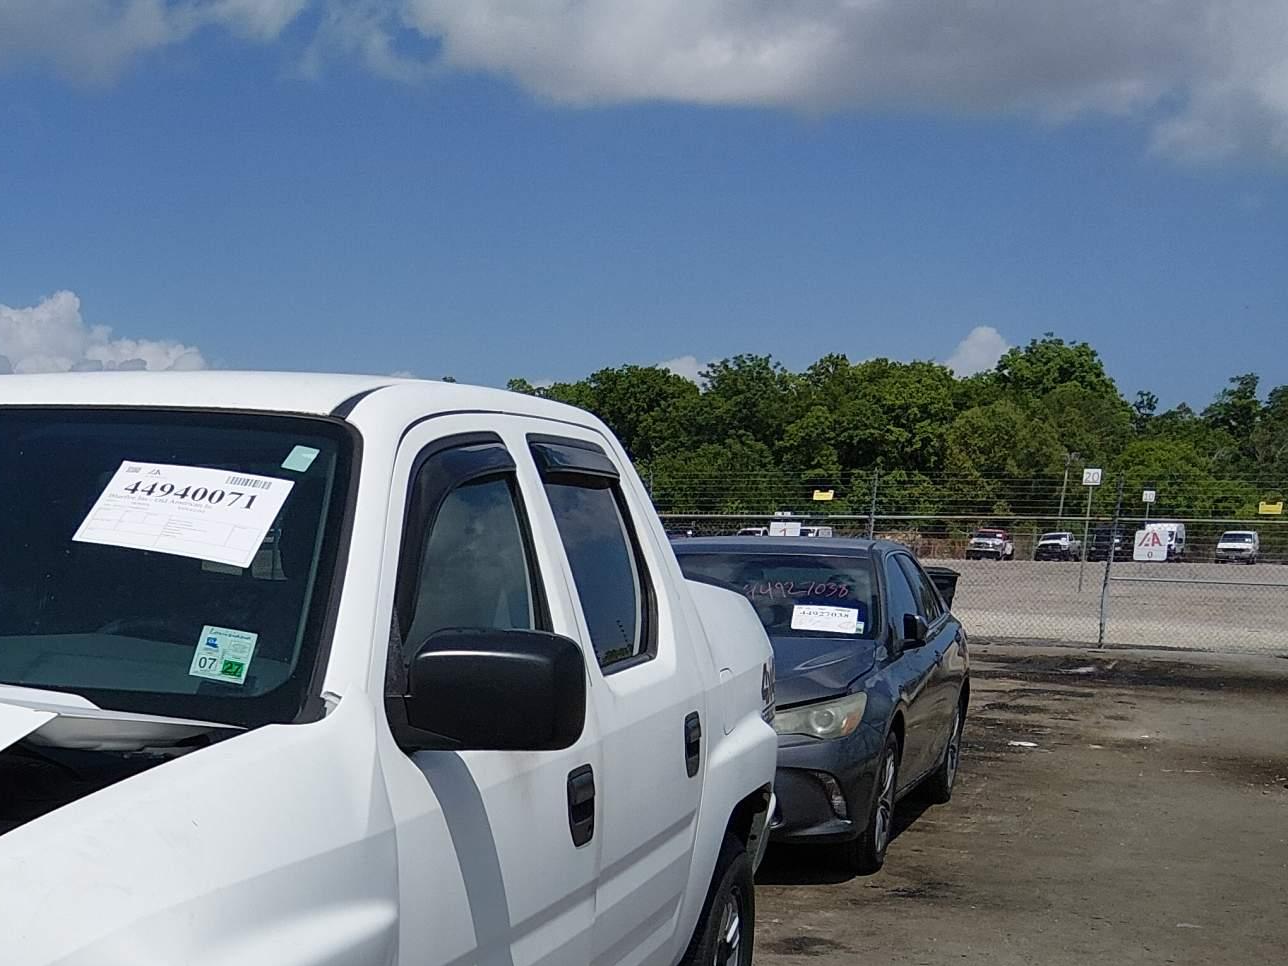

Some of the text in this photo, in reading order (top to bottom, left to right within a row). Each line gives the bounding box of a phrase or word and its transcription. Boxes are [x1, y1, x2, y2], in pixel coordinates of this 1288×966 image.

[1085, 471, 1100, 483] 20
[124, 480, 258, 510] 44940071
[1144, 493, 1155, 501] 10
[198, 656, 217, 670] 07
[224, 661, 243, 677] 27
